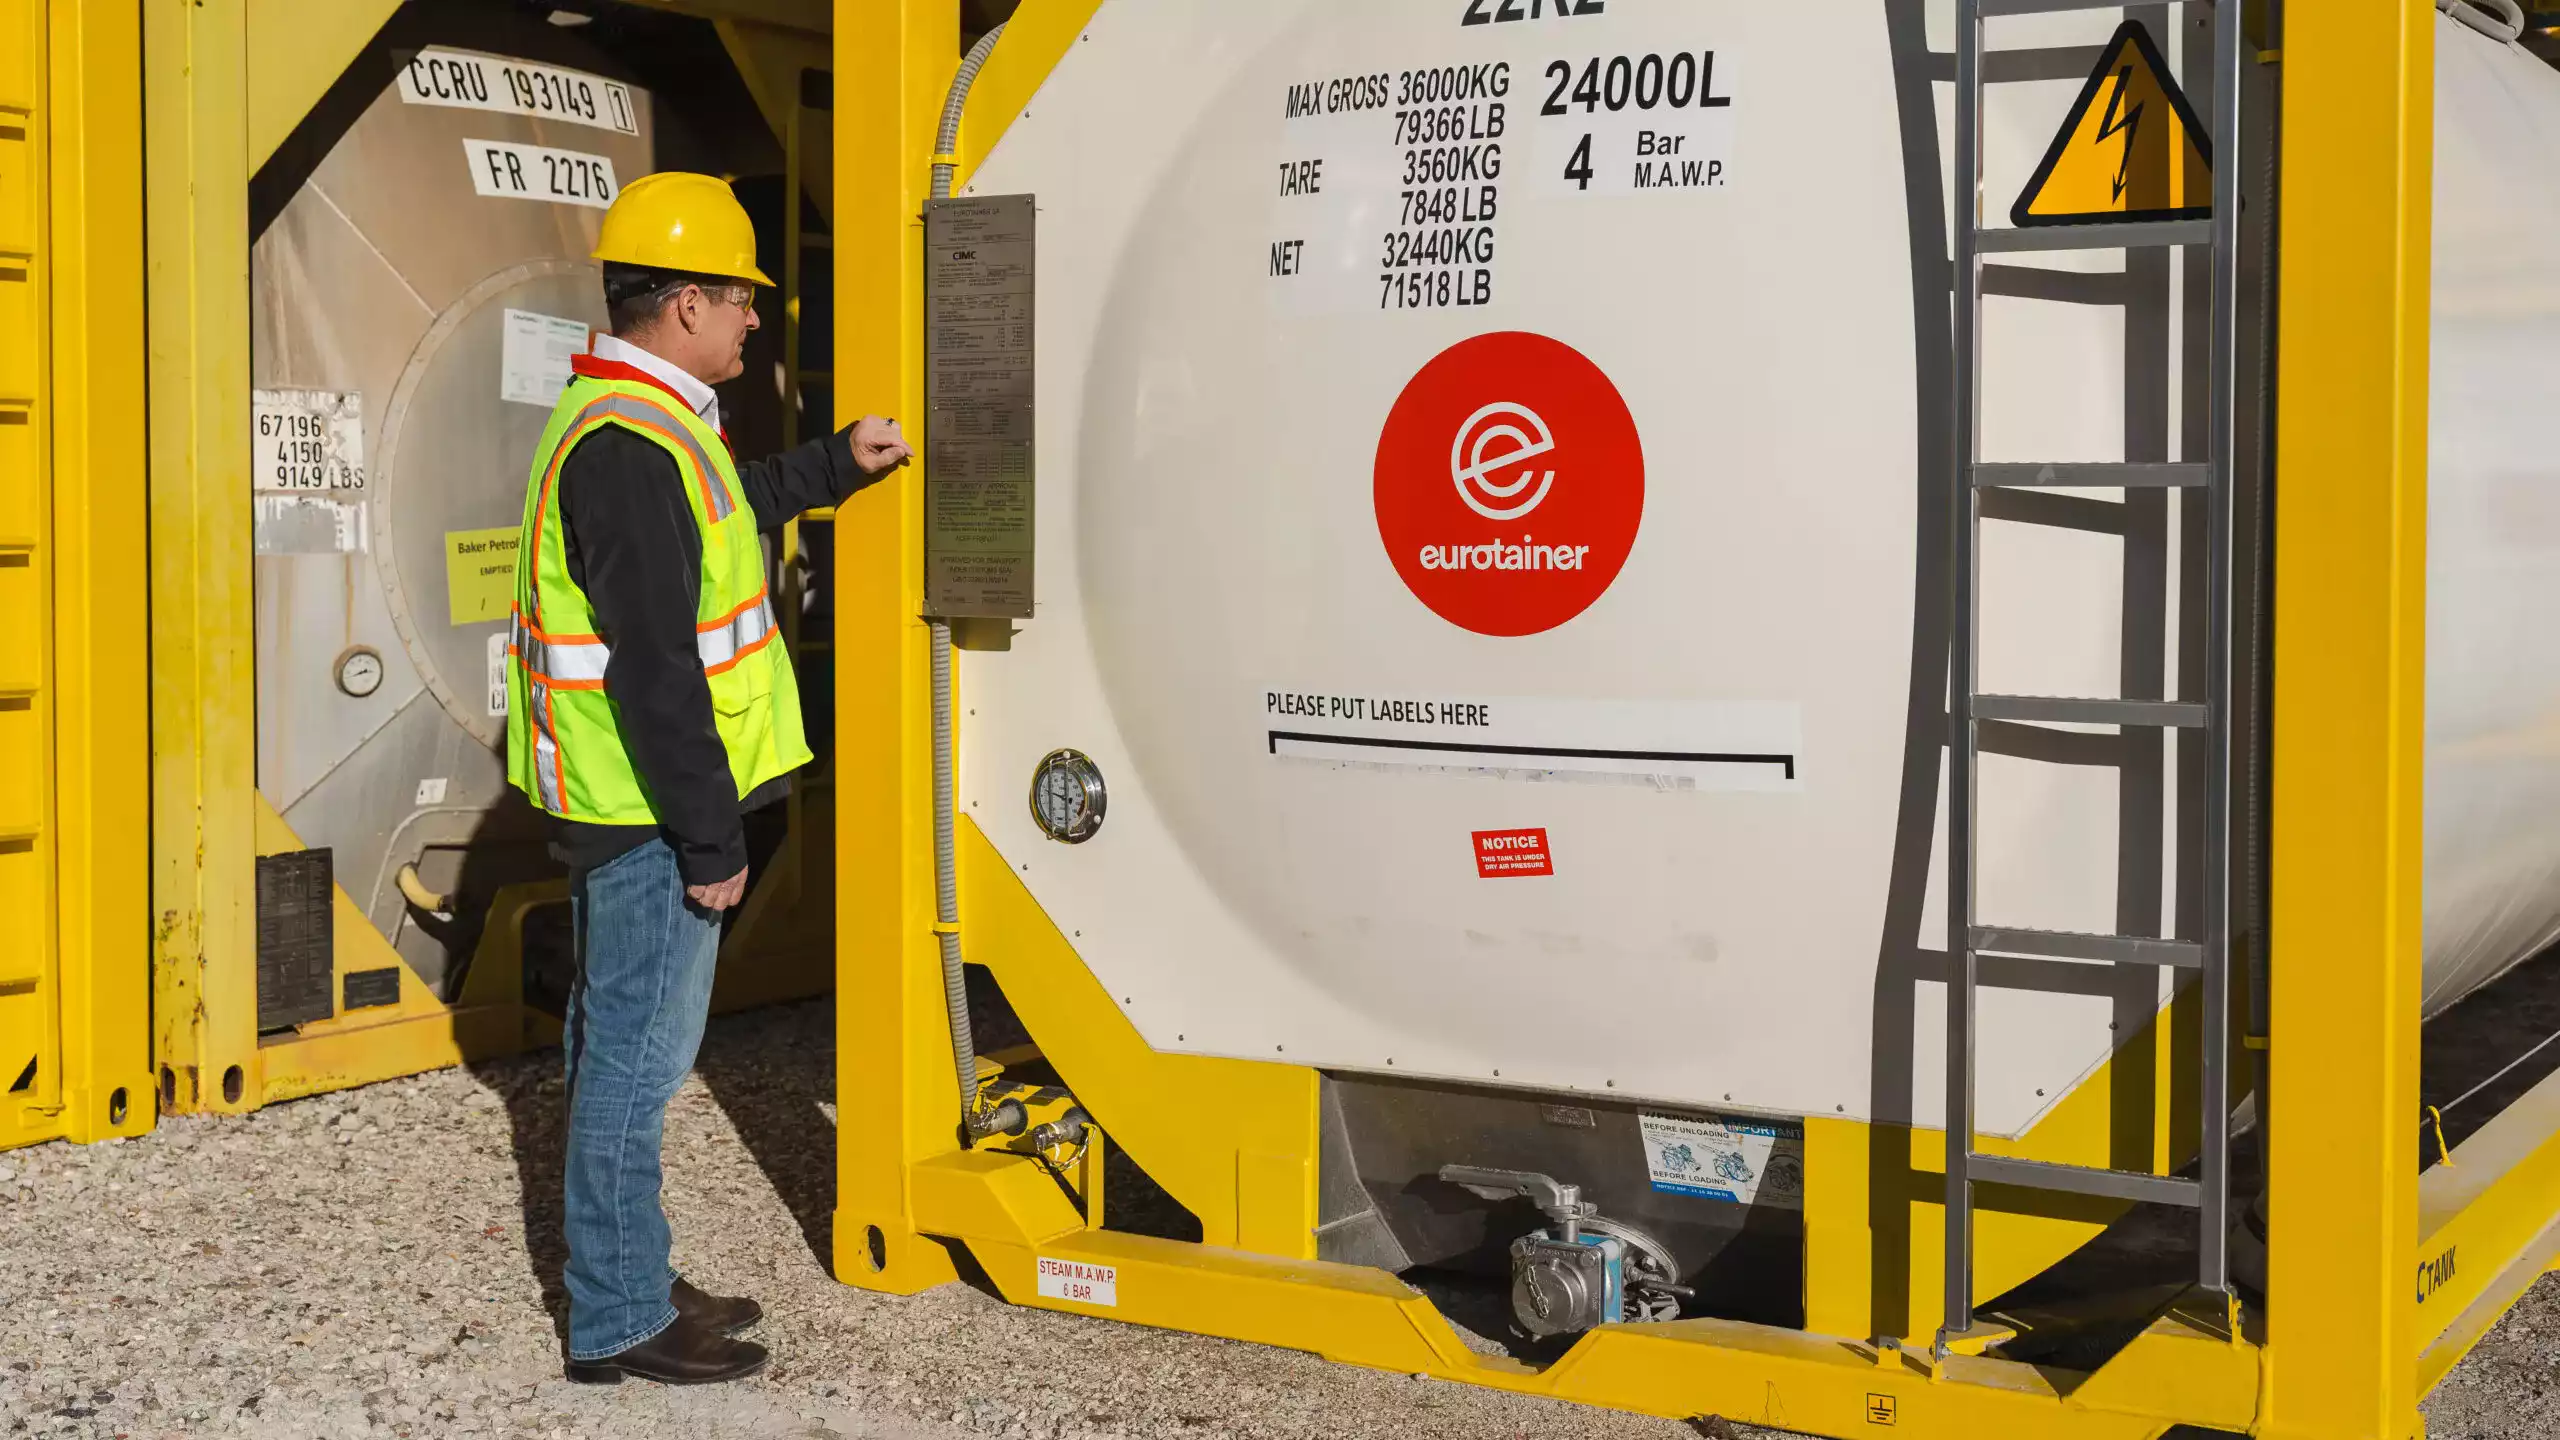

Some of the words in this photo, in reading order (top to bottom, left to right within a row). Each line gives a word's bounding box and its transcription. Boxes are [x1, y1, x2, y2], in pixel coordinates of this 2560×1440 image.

[409, 57, 488, 102] CCRU
[503, 67, 596, 120] 193149
[613, 90, 628, 128] 1
[1286, 83, 1324, 119] MAX
[1327, 73, 1390, 114] GROSS
[1397, 61, 1510, 106] 36000KG
[1540, 50, 1731, 117] 24000L
[1394, 105, 1465, 146] 79366
[1469, 102, 1505, 140] LB
[1279, 159, 1323, 197] TARE
[1402, 143, 1501, 185] 3560KG
[1564, 133, 1594, 191] 4
[1636, 131, 1685, 157] Bar
[486, 149, 526, 192] FR
[542, 155, 609, 201] 2276
[1634, 160, 1724, 189] M.A.W.P.
[1400, 188, 1457, 226] 7848
[1462, 185, 1498, 223] LB
[952, 251, 977, 261] CIMC
[1270, 240, 1304, 277] NET
[1381, 227, 1494, 269] 32440KG
[1380, 270, 1451, 309] 71518
[1456, 268, 1491, 306] LB
[260, 414, 321, 437] 67196
[277, 441, 322, 463] 4150
[277, 466, 322, 488] 9149
[330, 466, 364, 489] LBS
[458, 541, 486, 554] Baker
[1419, 534, 1589, 571] eurotainer
[1267, 692, 1325, 717] PLEASE
[1331, 696, 1365, 720] PUT
[1371, 699, 1434, 725] LABELS
[1440, 703, 1490, 727] HERE
[1482, 836, 1539, 850] NOTICE
[1511, 861, 1545, 869] PRESSURE
[1523, 853, 1545, 861] UNDER
[1643, 1122, 1678, 1132] BEFORE
[1680, 1127, 1730, 1139] UNLOADING
[1728, 1120, 1800, 1139] IMPORTANT
[1653, 1170, 1686, 1180] BEFORE
[1689, 1174, 1727, 1185] LOADING
[1039, 1260, 1072, 1277] STEAM
[1075, 1264, 1115, 1284] M.A.W.P.
[1063, 1283, 1069, 1296] 6
[1072, 1284, 1091, 1299] BAR
